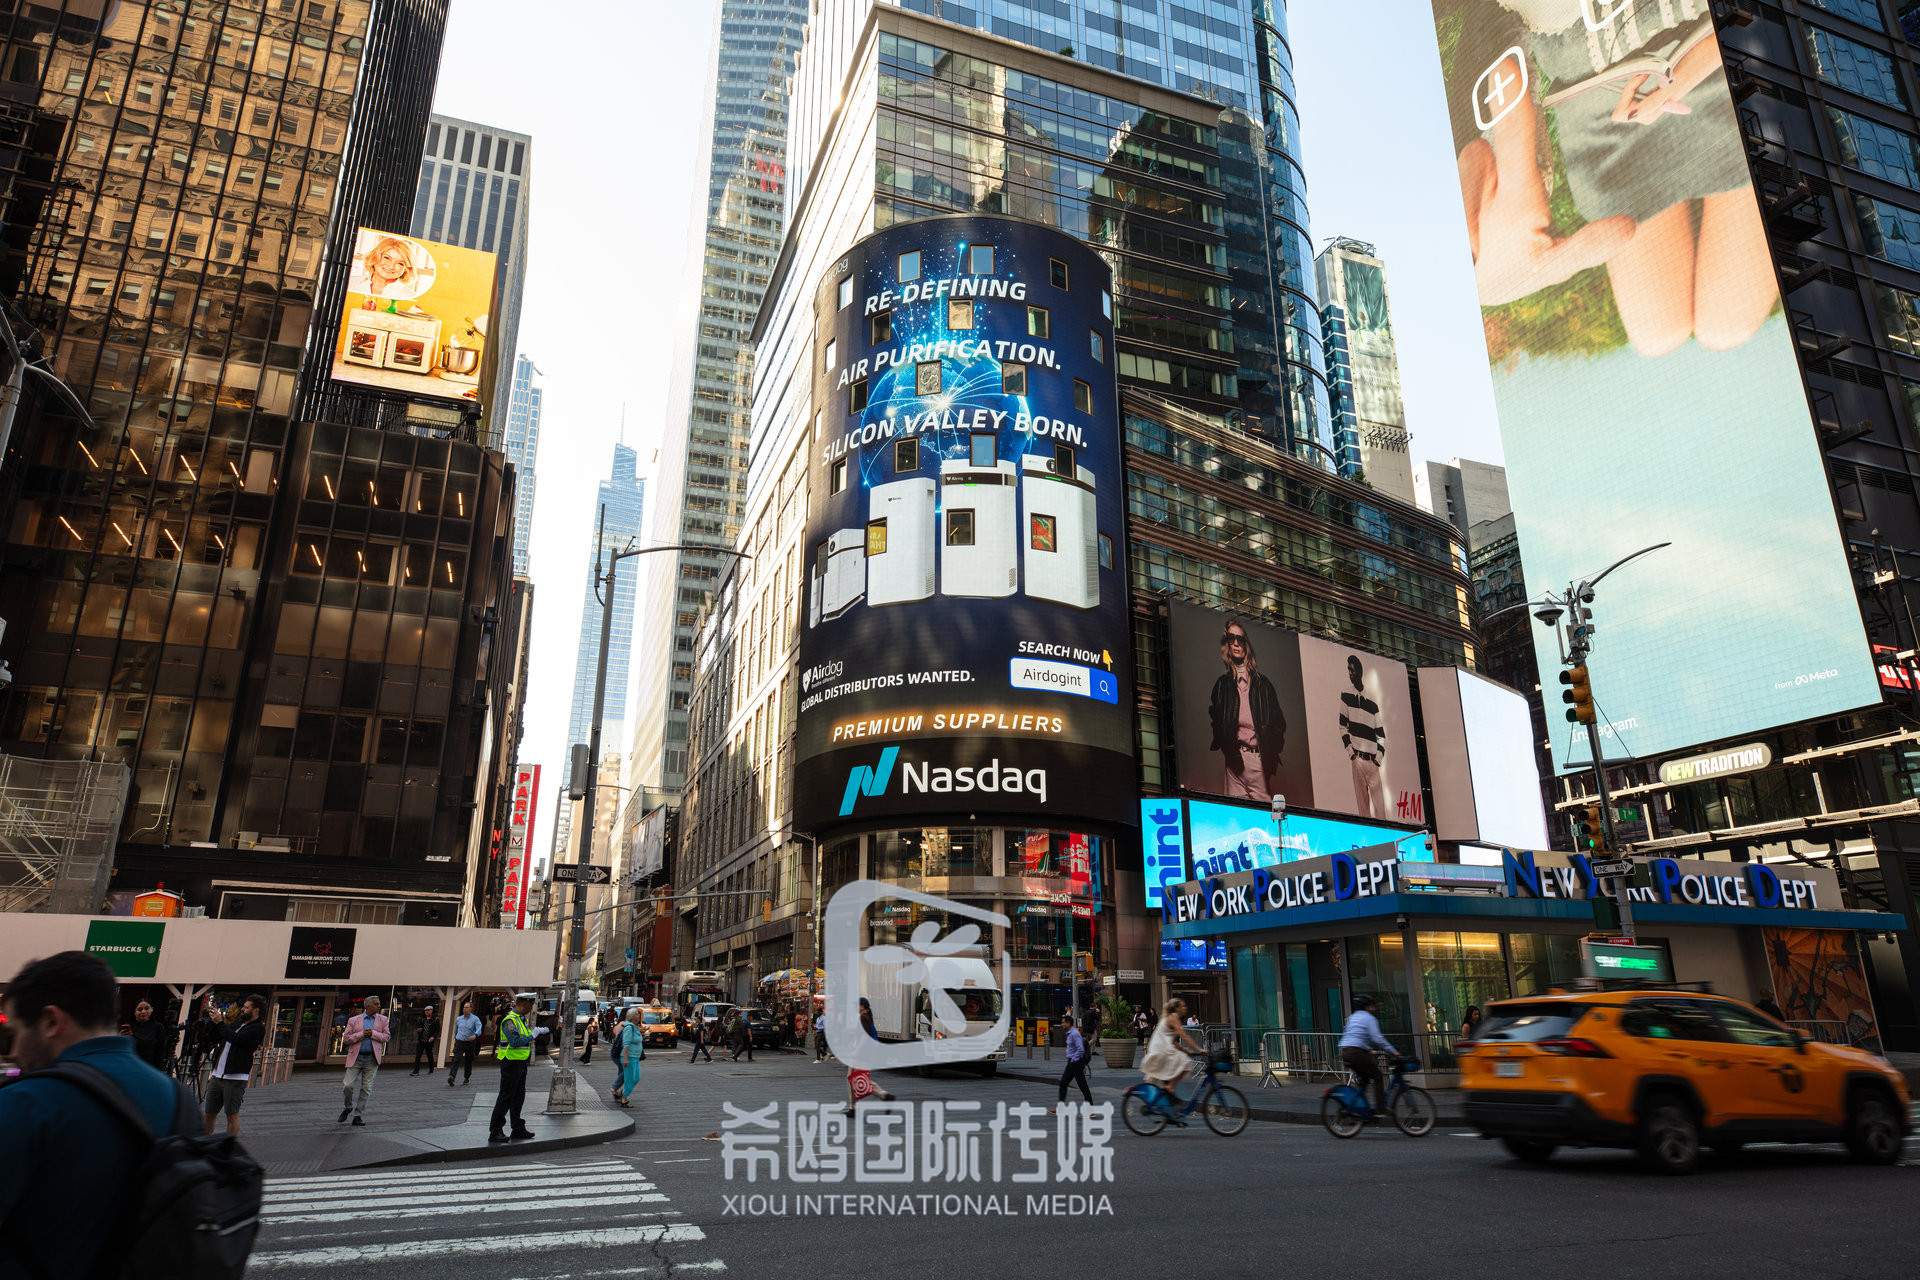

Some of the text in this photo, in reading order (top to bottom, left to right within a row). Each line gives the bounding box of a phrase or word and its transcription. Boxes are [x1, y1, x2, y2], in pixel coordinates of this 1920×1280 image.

[864, 278, 1027, 316] RE-DEFINING
[836, 338, 1062, 391] AIR PURIFICATION.
[821, 408, 1088, 467] SILICON VALLEY BORN.
[1018, 640, 1101, 664] SEARCH NOW
[811, 660, 843, 682] Airdog
[1023, 667, 1082, 687] Airdogint
[1774, 668, 1838, 690] from Meta
[801, 670, 976, 713] GLOBAL DISTRIBUTORS WANTED.
[833, 713, 1063, 742] PREMIUM SUPPLIERS
[1570, 717, 1639, 744] Insagram
[902, 758, 1047, 803] Nasdaq
[513, 772, 531, 825] PARK
[1396, 790, 1422, 822] H&M
[1502, 848, 1576, 898] NEW
[1653, 858, 1749, 907] POLICE
[1748, 864, 1818, 910] DEPT
[1595, 863, 1628, 874] ONE WAY
[503, 857, 521, 913] PARK
[1162, 853, 1399, 924] NEW YORK POLICE DEPT
[1026, 906, 1047, 914] Nasdaq
[89, 945, 142, 953] STARBUCKS
